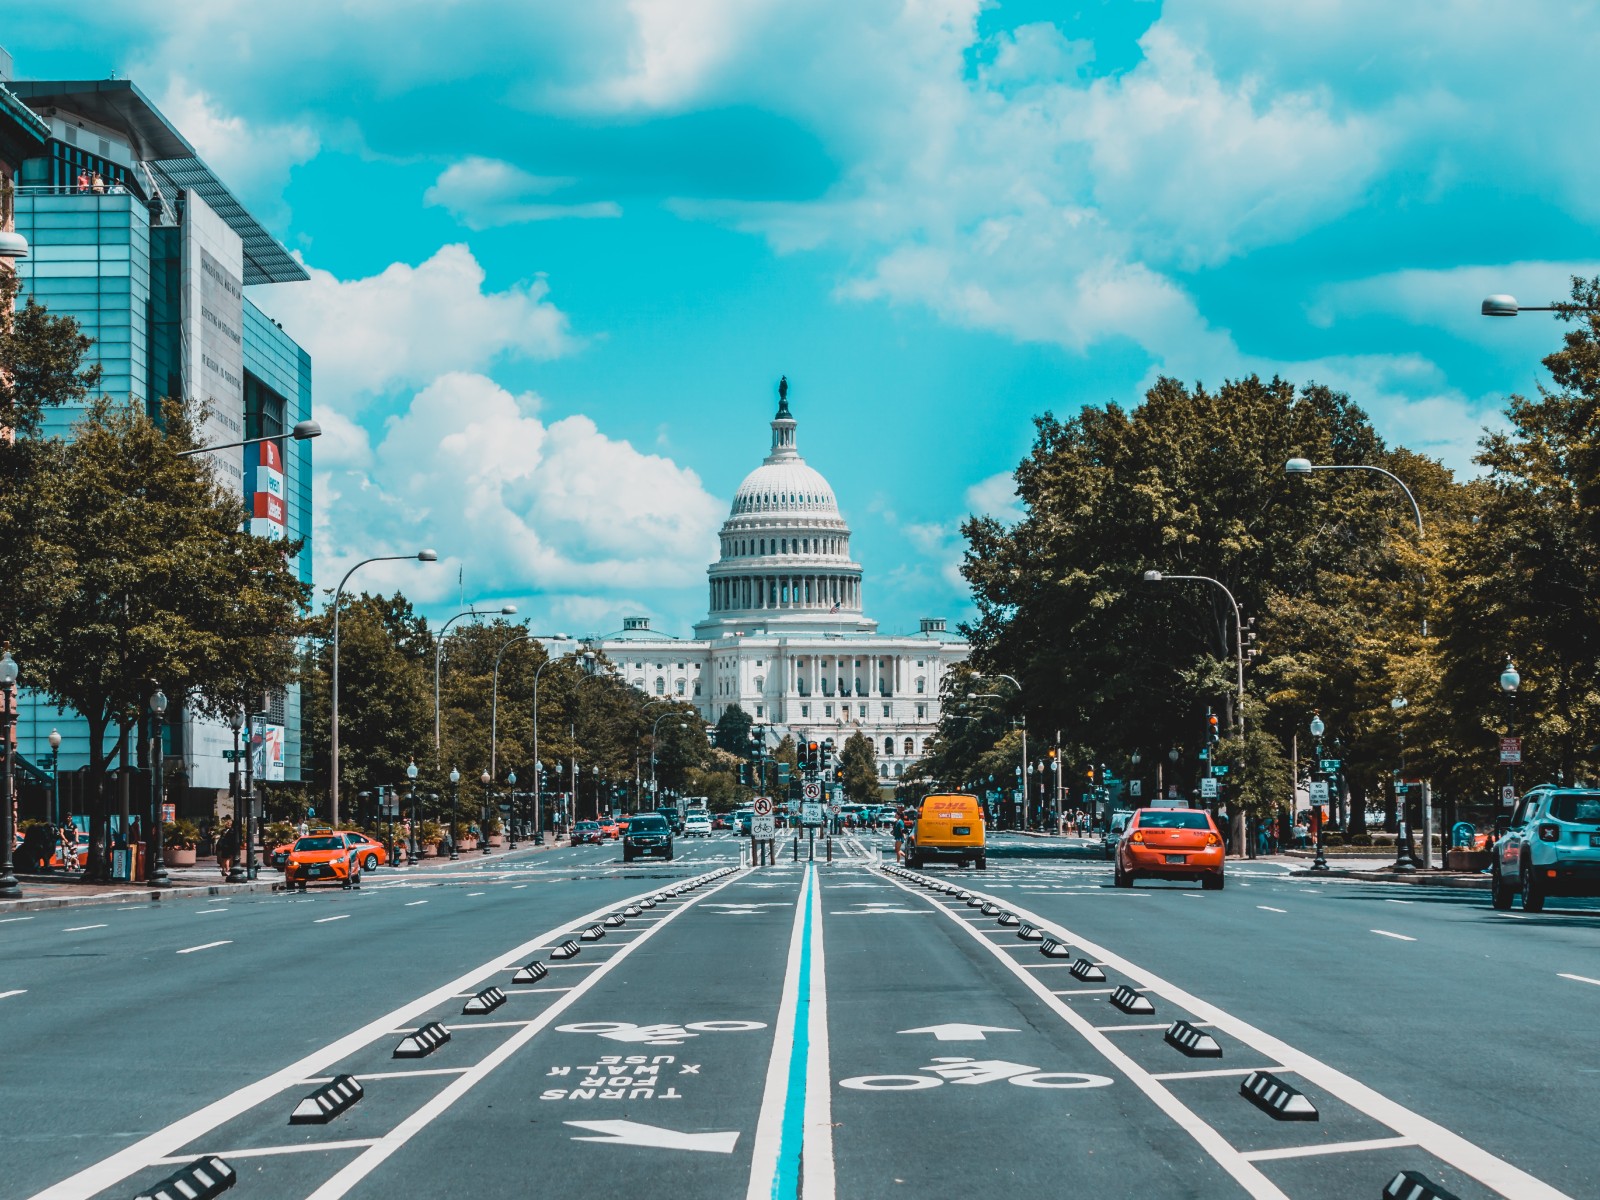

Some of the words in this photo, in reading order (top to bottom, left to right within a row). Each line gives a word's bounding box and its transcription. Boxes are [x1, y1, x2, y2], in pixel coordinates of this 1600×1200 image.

[933, 802, 968, 810] DHL
[596, 1055, 675, 1065] USE
[545, 1065, 659, 1076] WALK
[679, 1064, 702, 1074] X
[579, 1076, 659, 1087] FOR
[539, 1087, 682, 1100] TURNS
